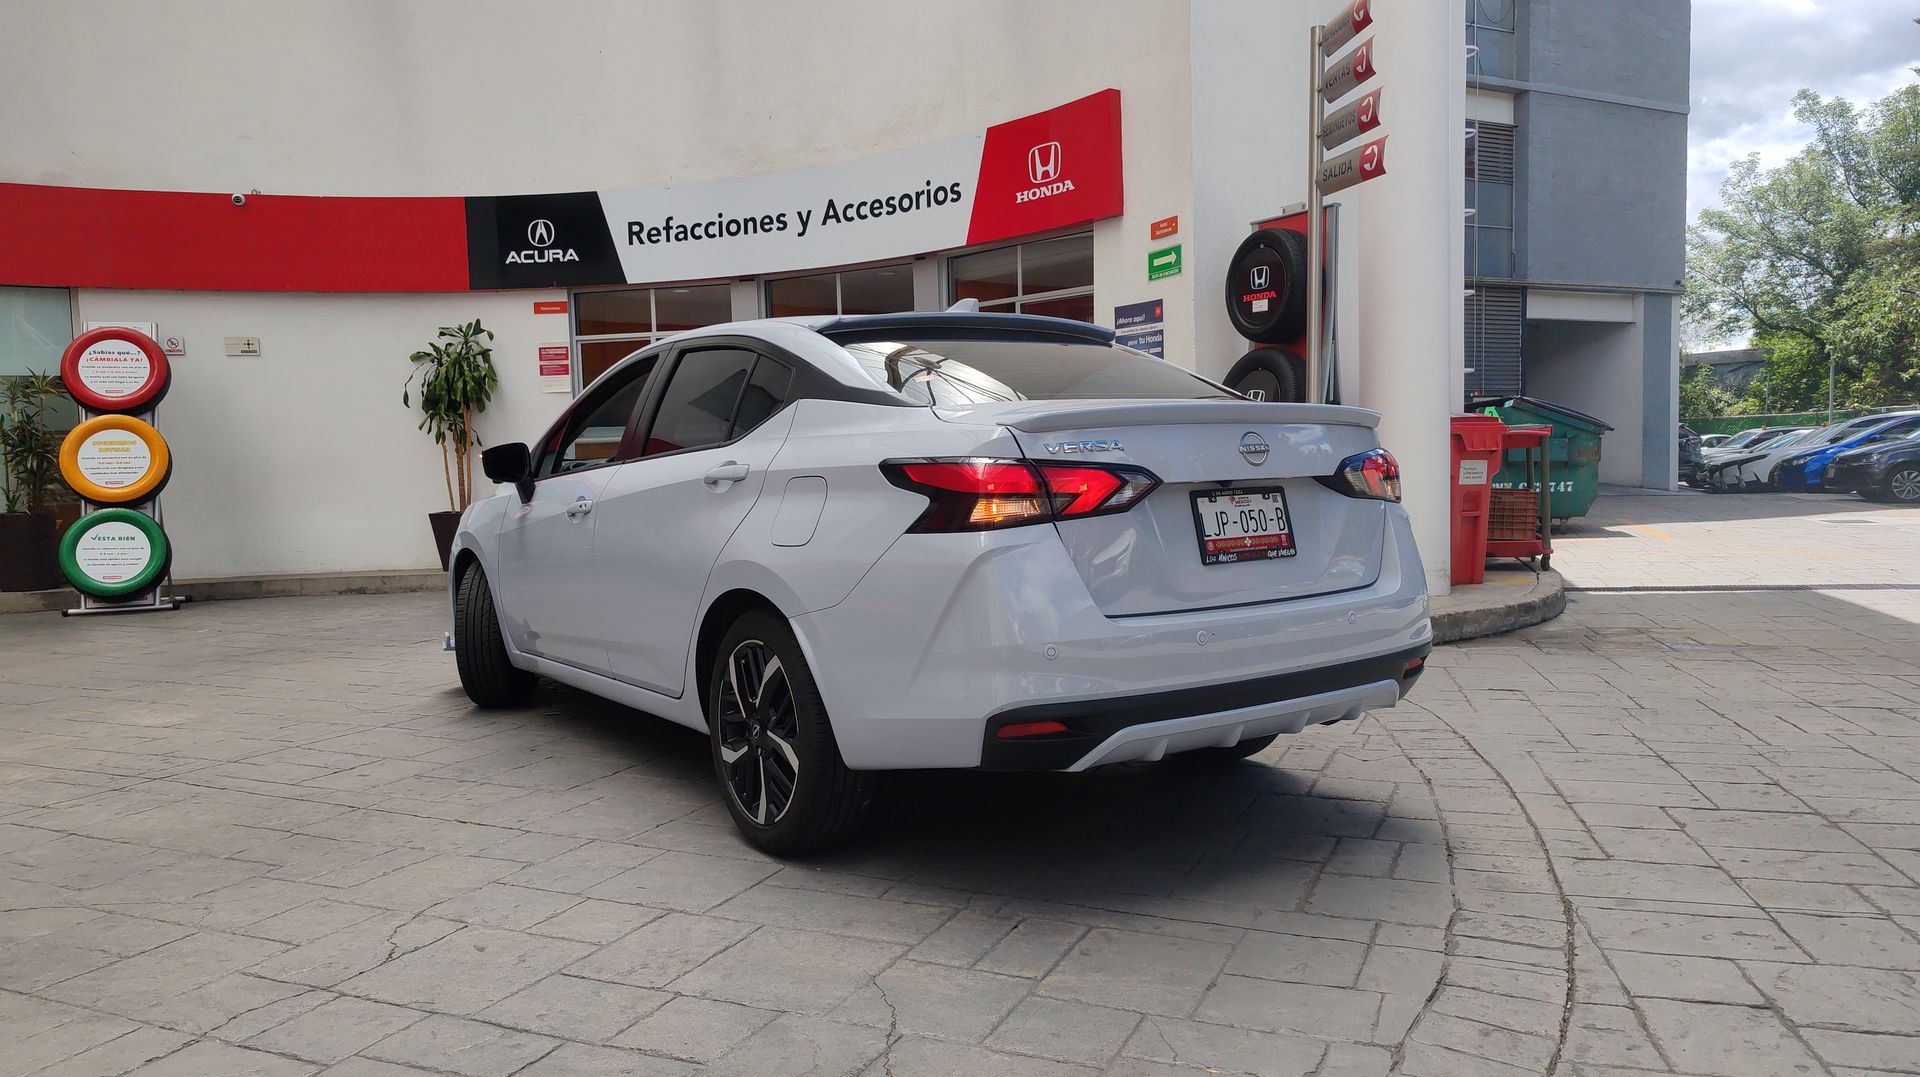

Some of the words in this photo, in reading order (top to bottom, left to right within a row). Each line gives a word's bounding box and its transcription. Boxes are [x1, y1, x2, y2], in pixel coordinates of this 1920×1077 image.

[1322, 159, 1353, 182] SALIDA
[1015, 180, 1076, 204] HONDA
[627, 212, 788, 247] Refacciones
[796, 208, 814, 238] y
[820, 180, 962, 227] Accesorios
[505, 249, 580, 265] ACURA
[1242, 290, 1278, 303] HONDA
[1145, 332, 1163, 343] Honda
[1043, 439, 1125, 455] VERSA
[1239, 443, 1270, 454] NISSAN
[1200, 507, 1286, 537] LJP-050-B
